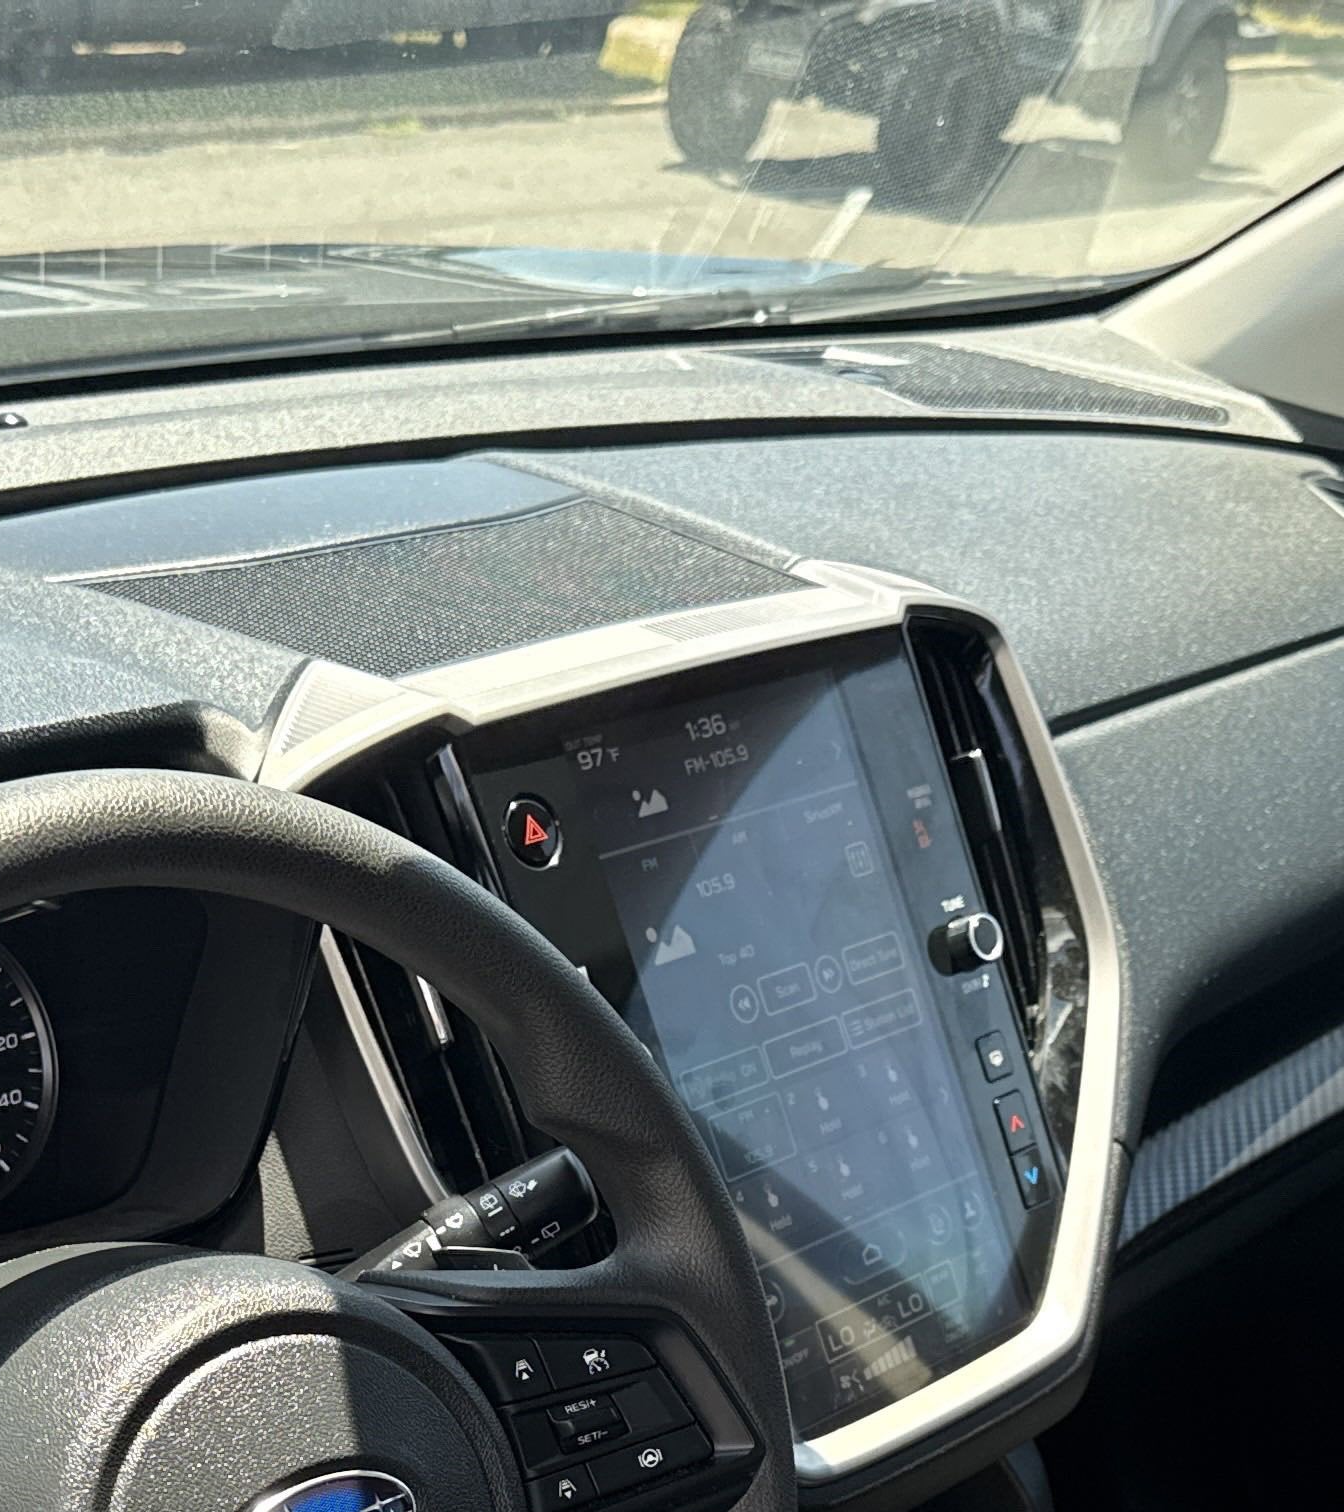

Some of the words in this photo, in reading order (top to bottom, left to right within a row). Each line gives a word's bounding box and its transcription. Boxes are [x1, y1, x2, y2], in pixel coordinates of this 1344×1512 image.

[685, 714, 727, 741] 1:36
[577, 747, 603, 770] 97
[684, 744, 749, 776] FM-105.9
[696, 873, 736, 898] 105.9
[897, 1292, 924, 1318] LO
[828, 1325, 855, 1351] LO
